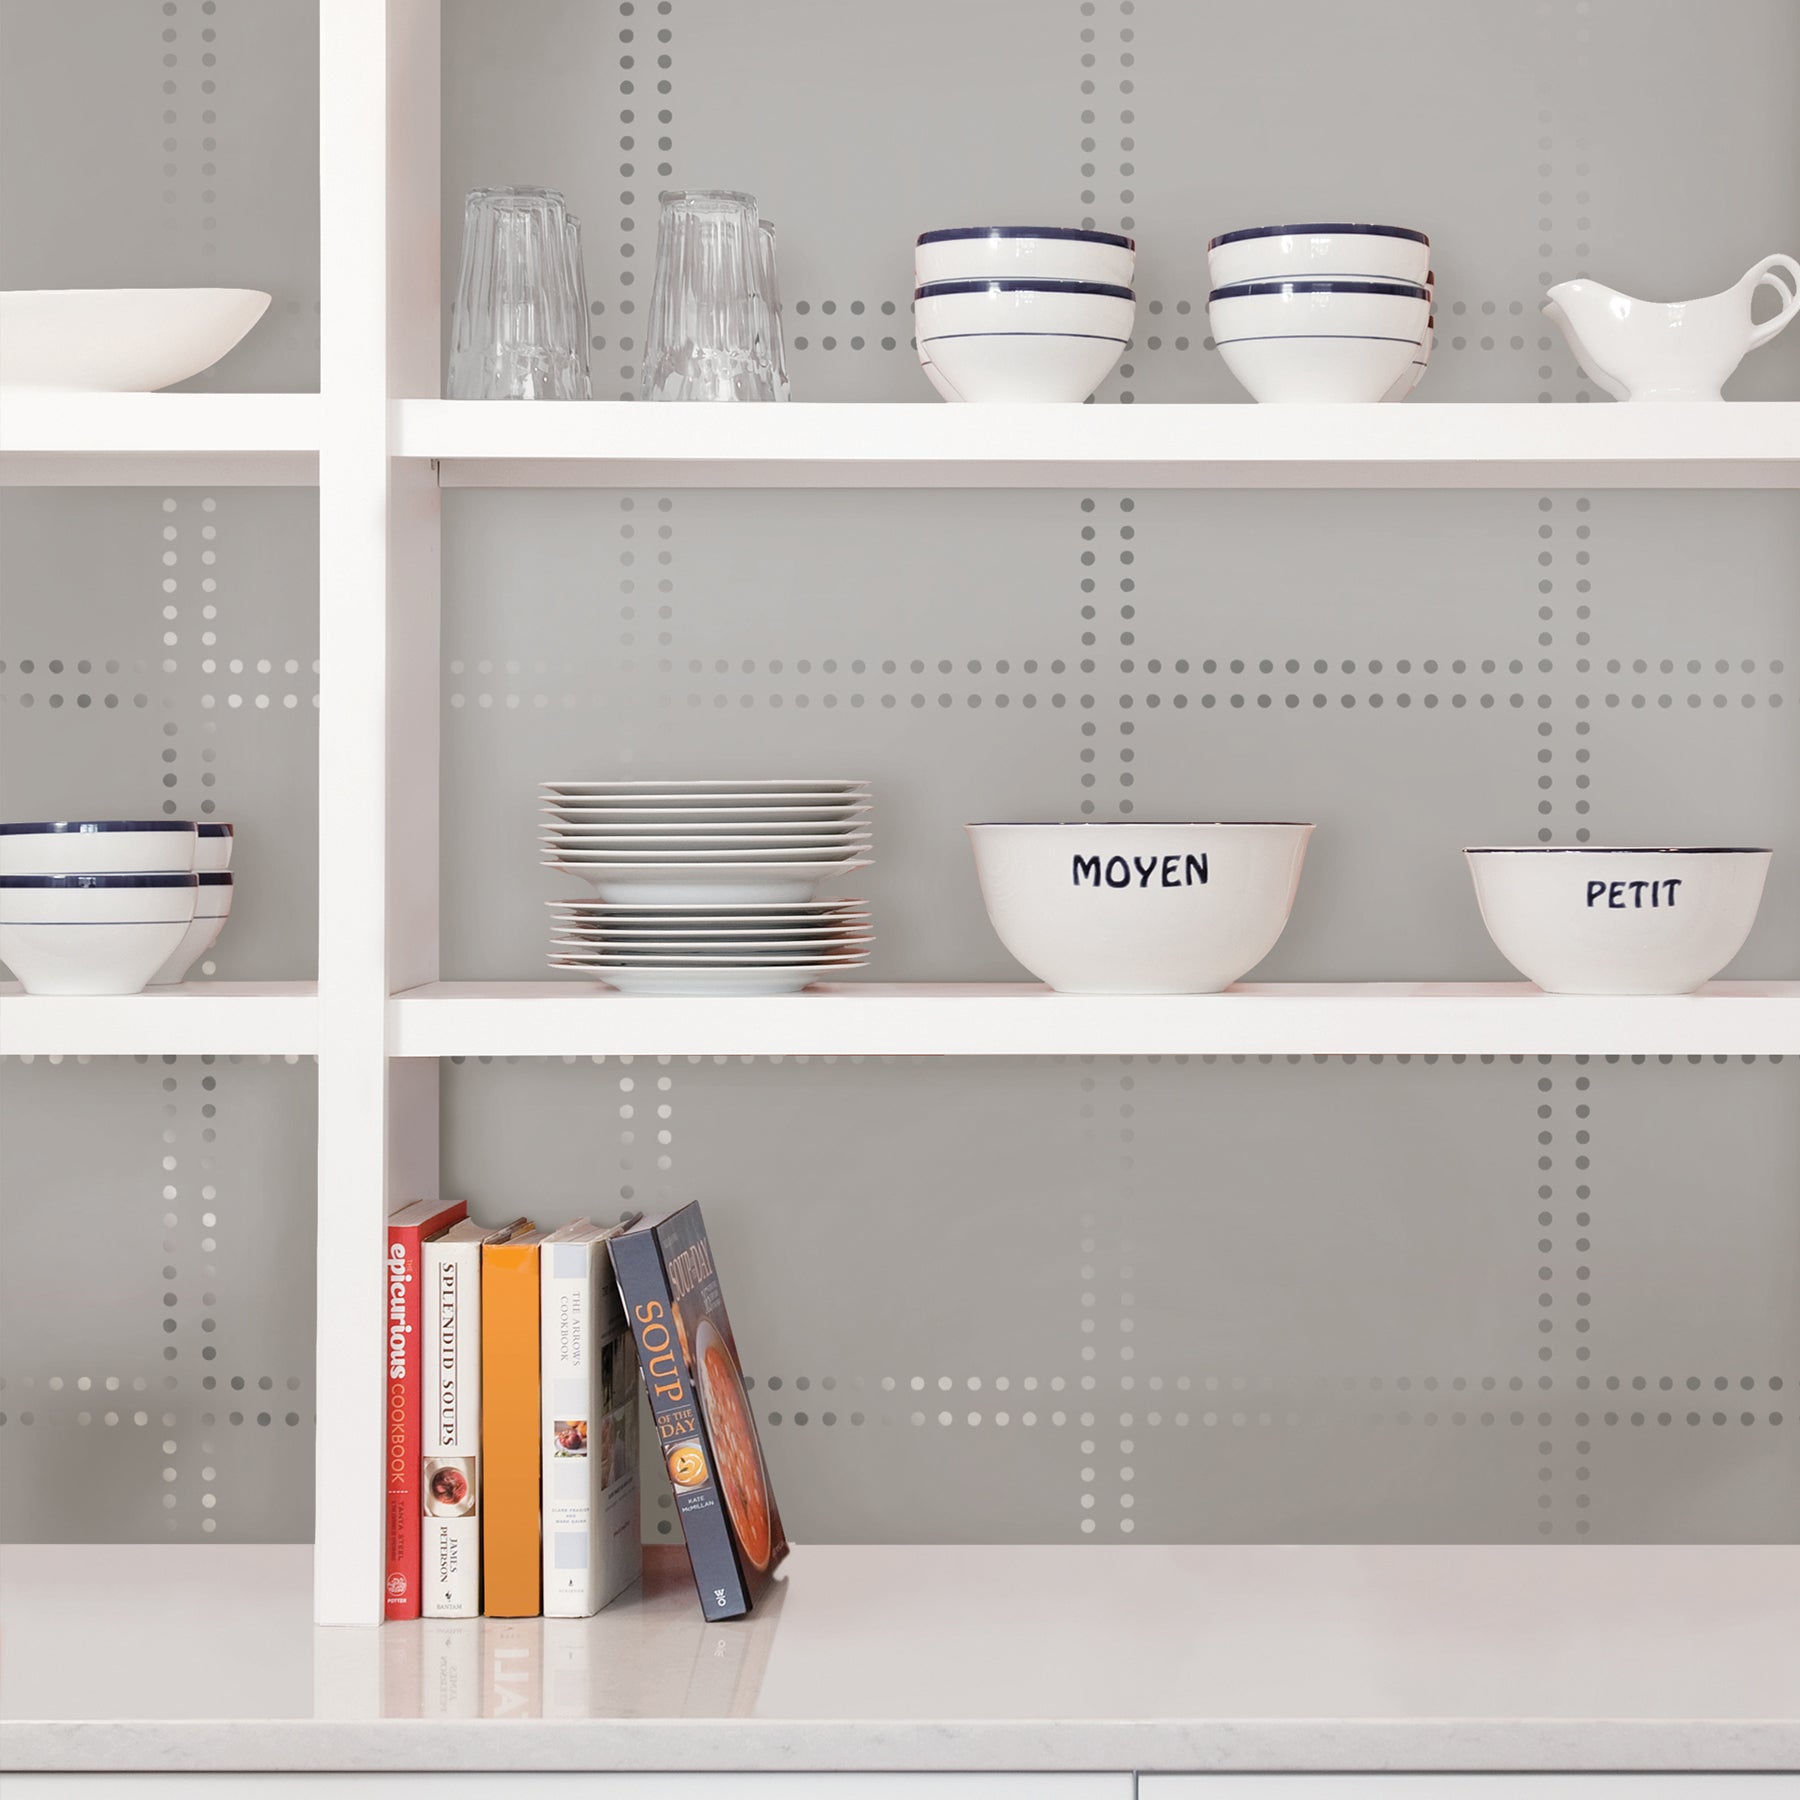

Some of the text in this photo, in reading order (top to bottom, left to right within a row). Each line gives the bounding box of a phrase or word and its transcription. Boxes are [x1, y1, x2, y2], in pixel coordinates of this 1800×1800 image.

[1073, 853, 1208, 888] MOYEN
[1587, 879, 1682, 908] PETIT
[560, 1296, 569, 1361] COOKBOOK
[572, 1291, 580, 1366] THE ARROWS
[635, 1300, 684, 1401] SOUP
[387, 1243, 412, 1483] epicurious COOKBOOK
[442, 1263, 454, 1446] SPLENDID SOUPS
[657, 1409, 693, 1425] OF THE
[660, 1418, 696, 1439] DAY
[688, 1495, 704, 1504] KATE
[440, 1526, 448, 1583] PETERSON
[450, 1538, 458, 1574] JAMES
